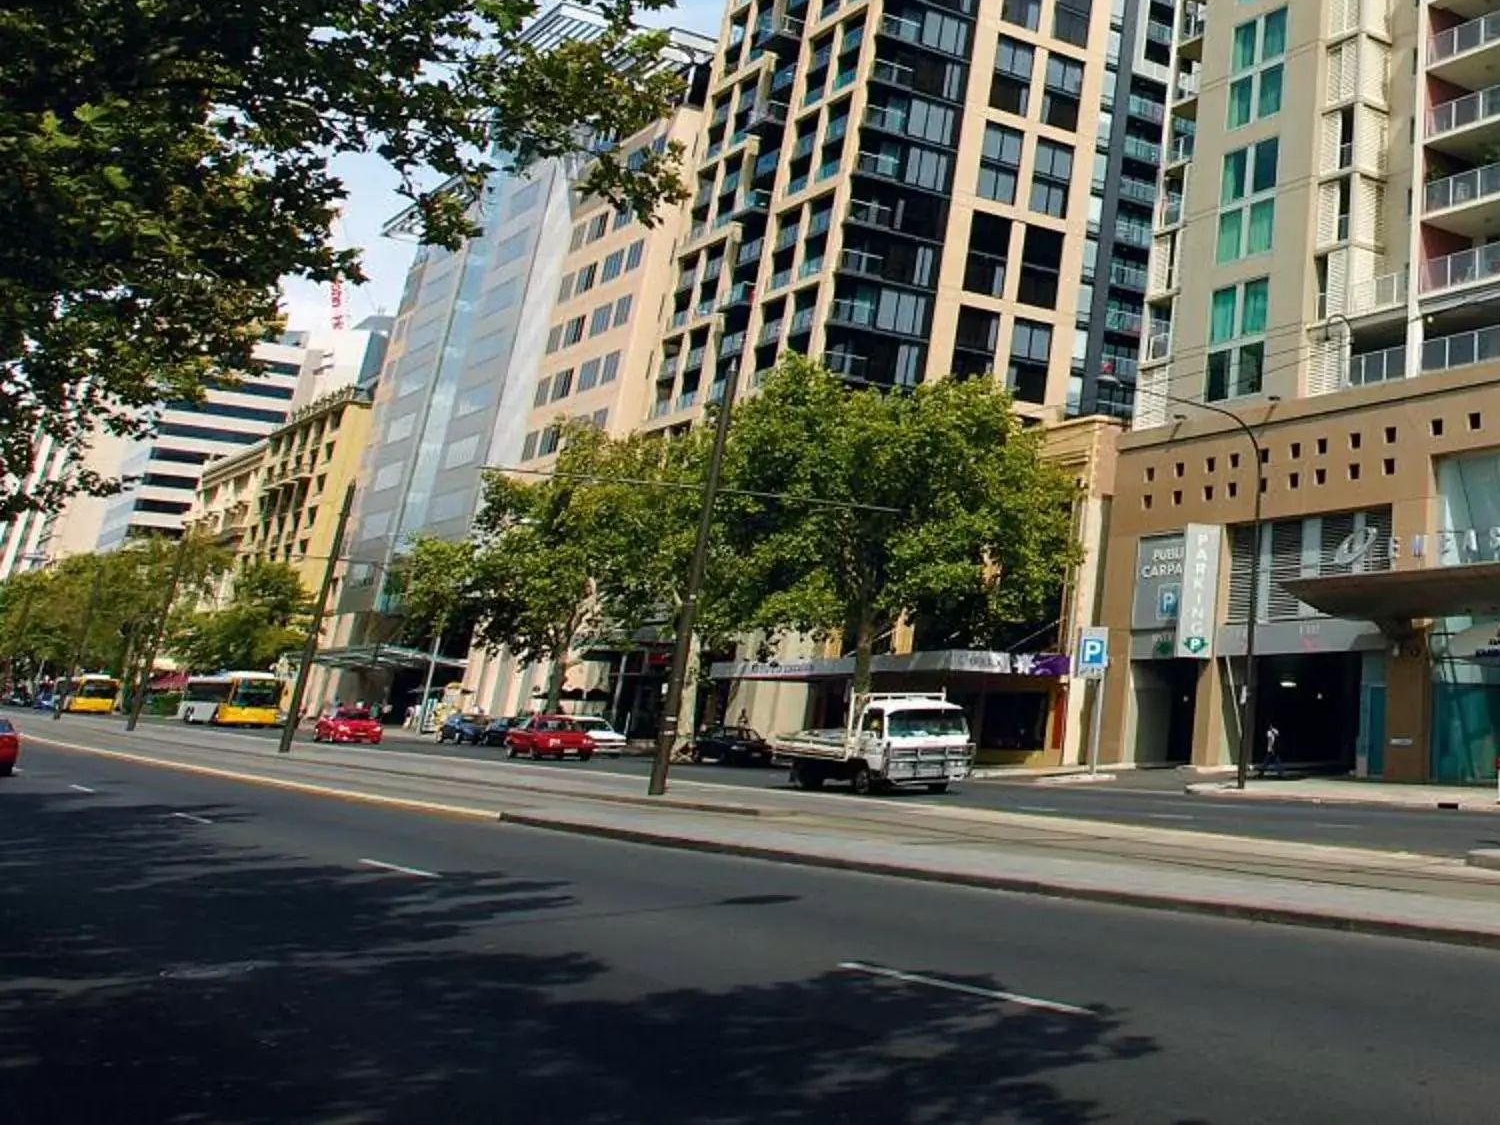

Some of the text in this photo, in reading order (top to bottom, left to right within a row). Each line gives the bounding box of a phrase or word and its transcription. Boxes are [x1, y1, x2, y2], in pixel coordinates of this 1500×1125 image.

[1153, 547, 1184, 560] PUBLI
[1141, 563, 1182, 577] CARPA
[1191, 533, 1209, 635] PARKING
[1085, 641, 1101, 662] P
